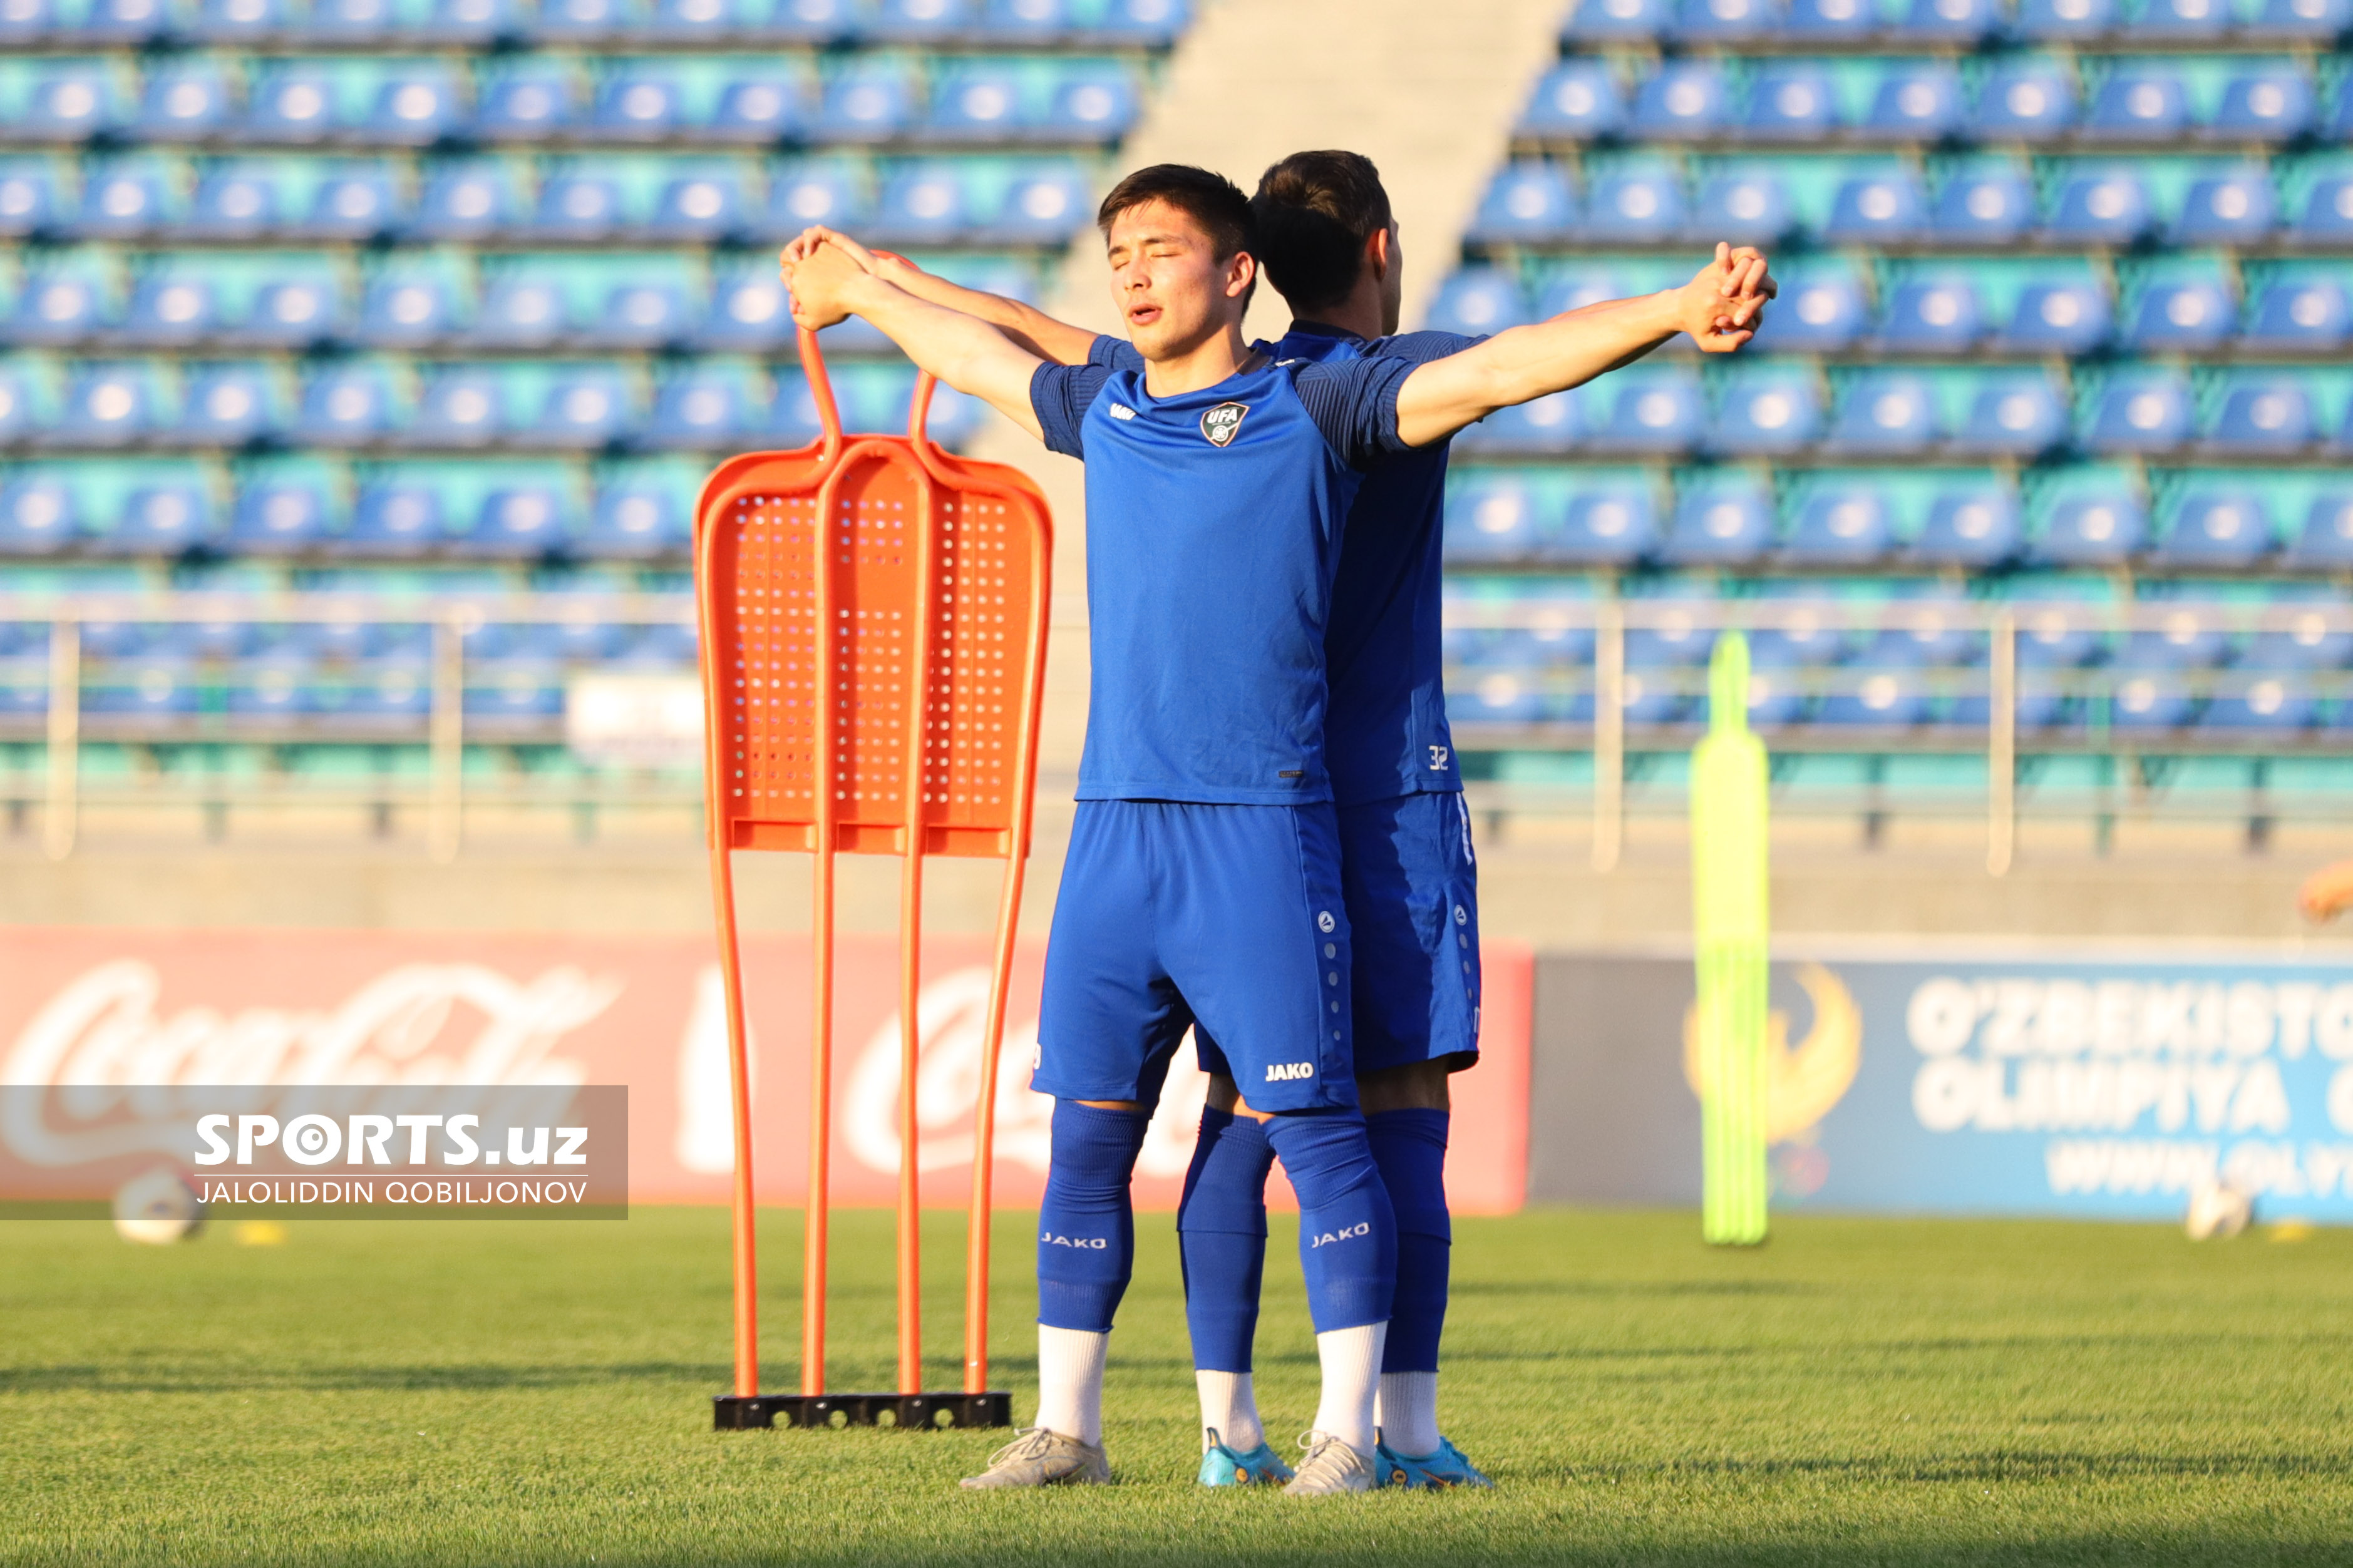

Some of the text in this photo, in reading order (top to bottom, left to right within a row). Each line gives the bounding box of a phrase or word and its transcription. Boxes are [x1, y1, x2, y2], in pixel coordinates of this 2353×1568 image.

[1207, 408, 1238, 424] UFA
[1429, 745, 1449, 771] 32
[1265, 1062, 1314, 1082] JAKO
[1040, 1231, 1108, 1249] JAKO
[1311, 1221, 1370, 1248] JAKO
